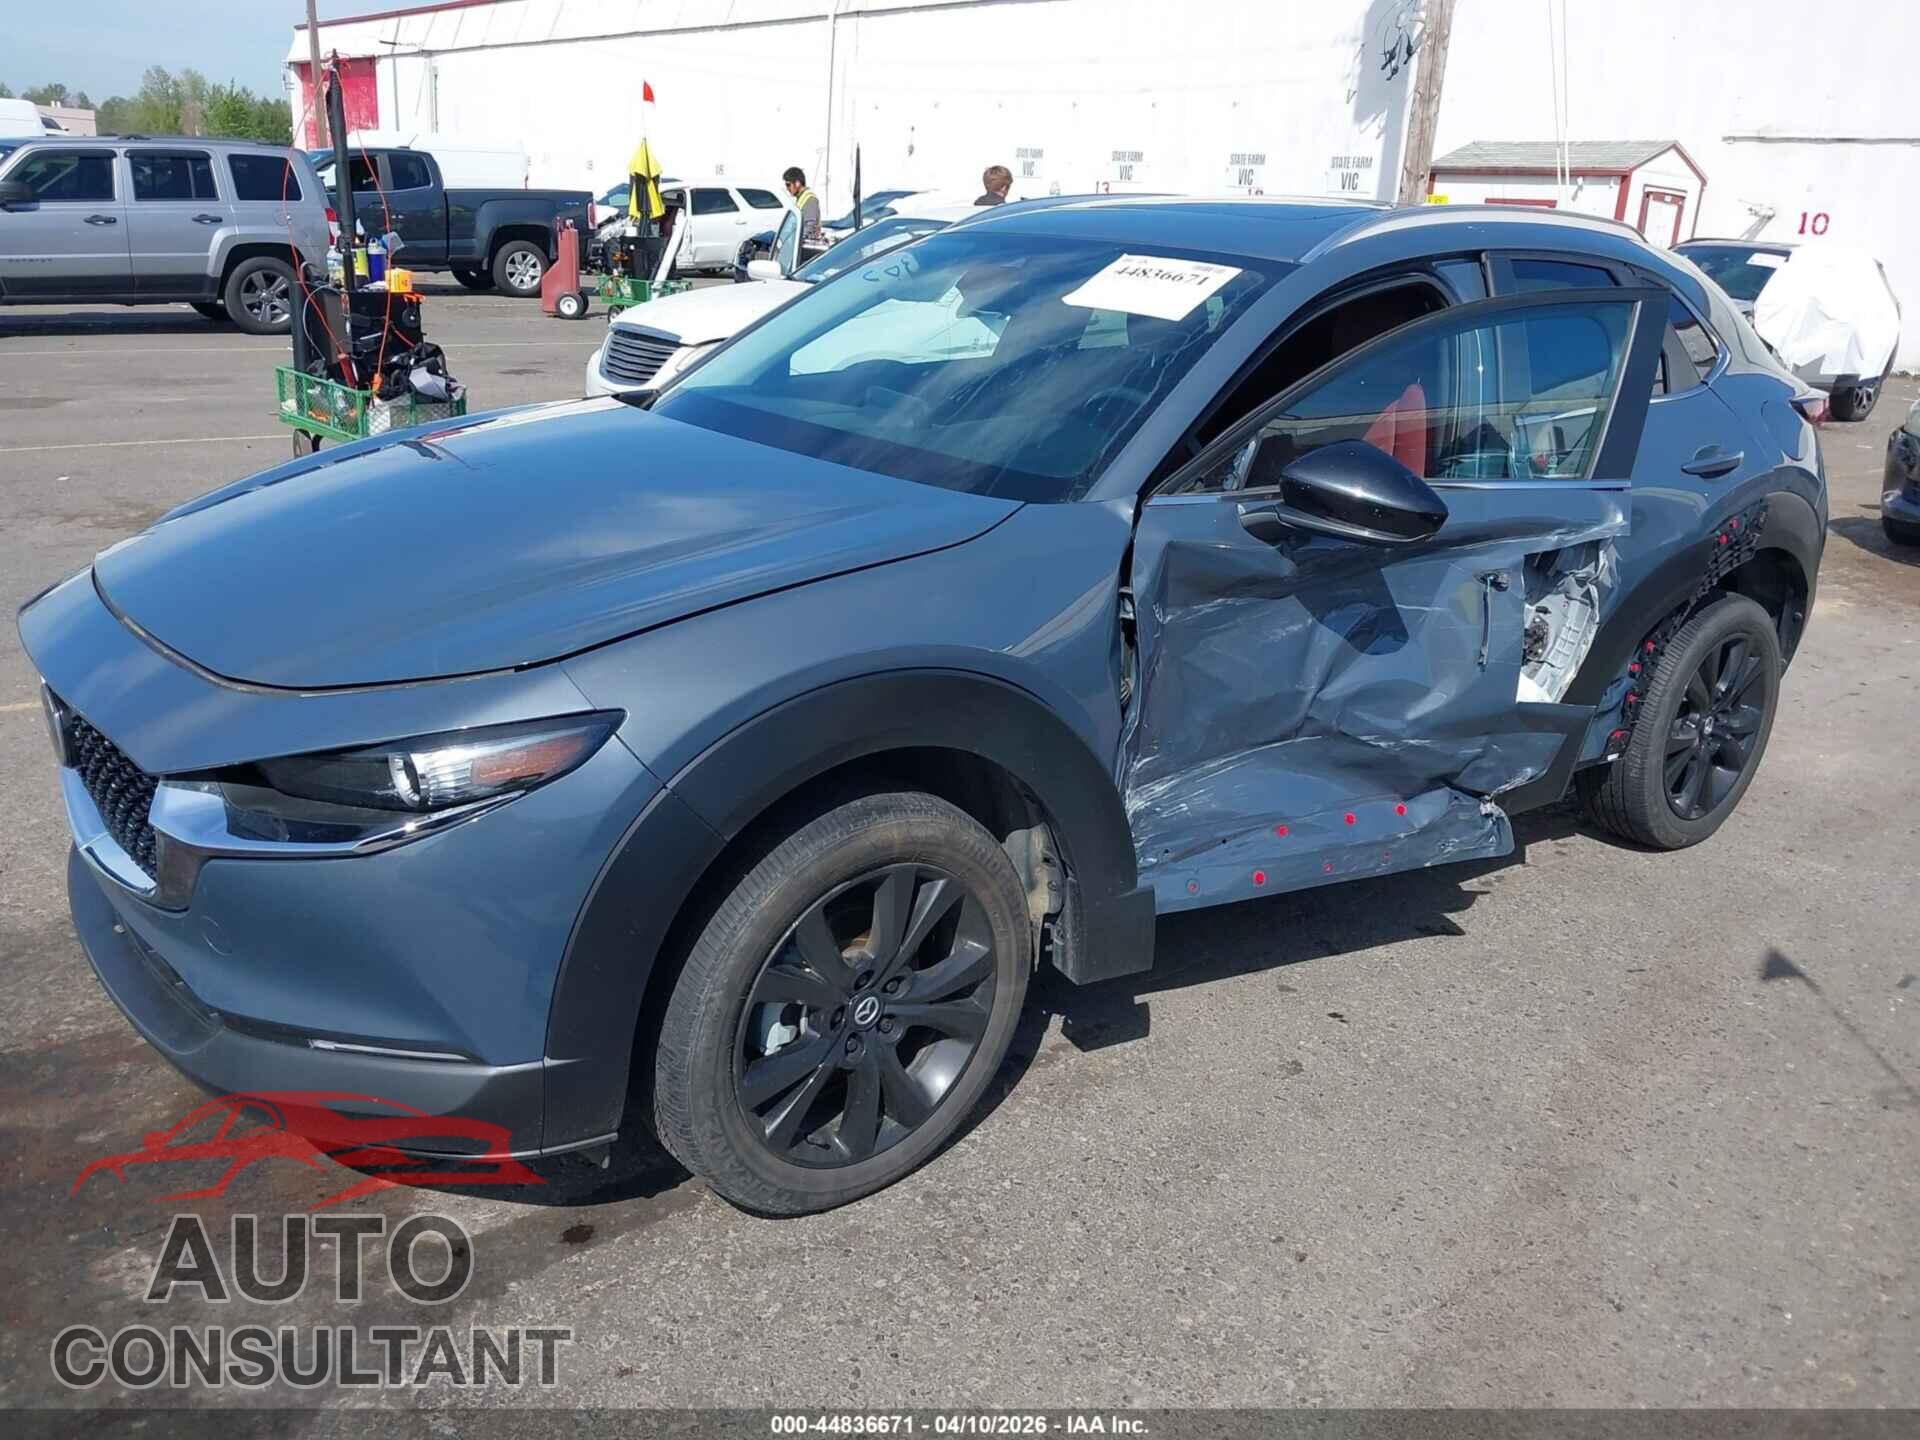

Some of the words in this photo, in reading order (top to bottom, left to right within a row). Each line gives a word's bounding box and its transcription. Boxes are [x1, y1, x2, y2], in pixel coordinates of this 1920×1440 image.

[1230, 153, 1247, 165] STATE
[1248, 153, 1266, 165] FARM
[1331, 156, 1351, 169] STATE
[1352, 156, 1374, 169] FARM
[1119, 164, 1133, 181] VIC
[1238, 167, 1255, 186] VIC
[1341, 171, 1360, 191] VIC
[1797, 211, 1830, 235] 10
[1114, 265, 1209, 286] 44836671
